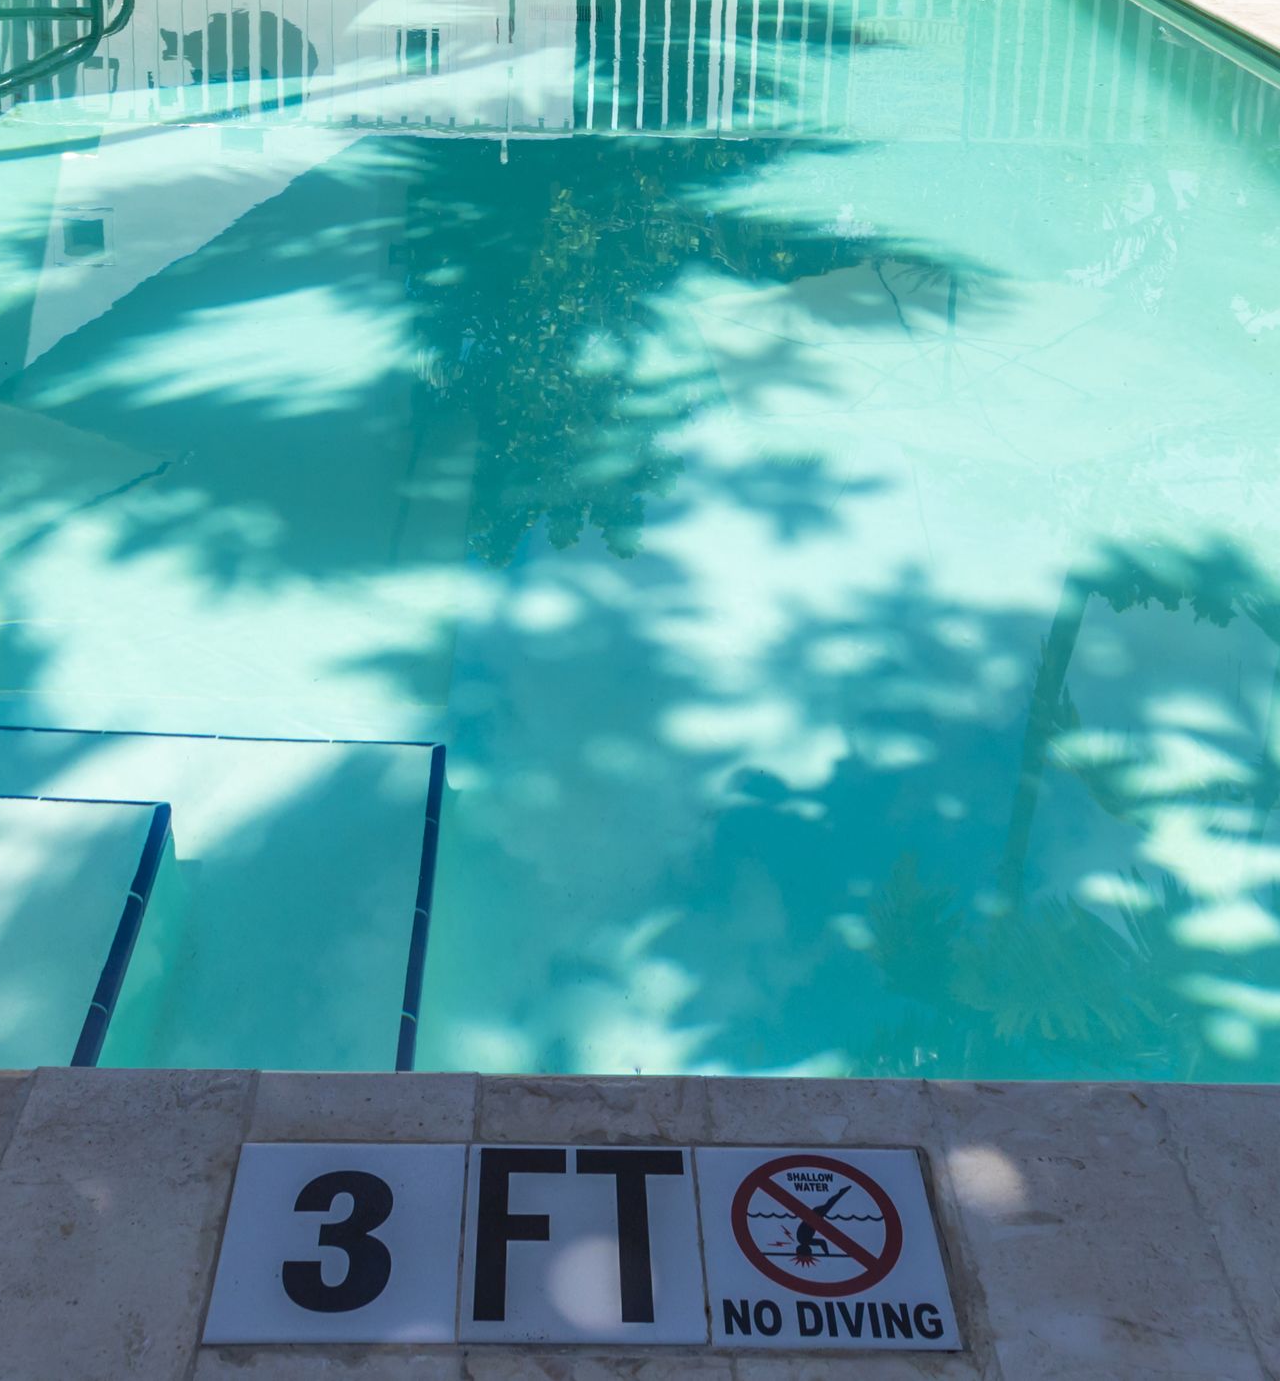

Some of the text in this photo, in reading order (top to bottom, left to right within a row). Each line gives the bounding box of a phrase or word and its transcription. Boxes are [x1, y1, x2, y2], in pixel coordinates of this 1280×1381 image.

[786, 1172, 834, 1182] SHALLOW
[794, 1182, 830, 1192] WATER
[281, 1147, 684, 1324] 3 FT
[722, 1299, 944, 1340] NO DIVING
